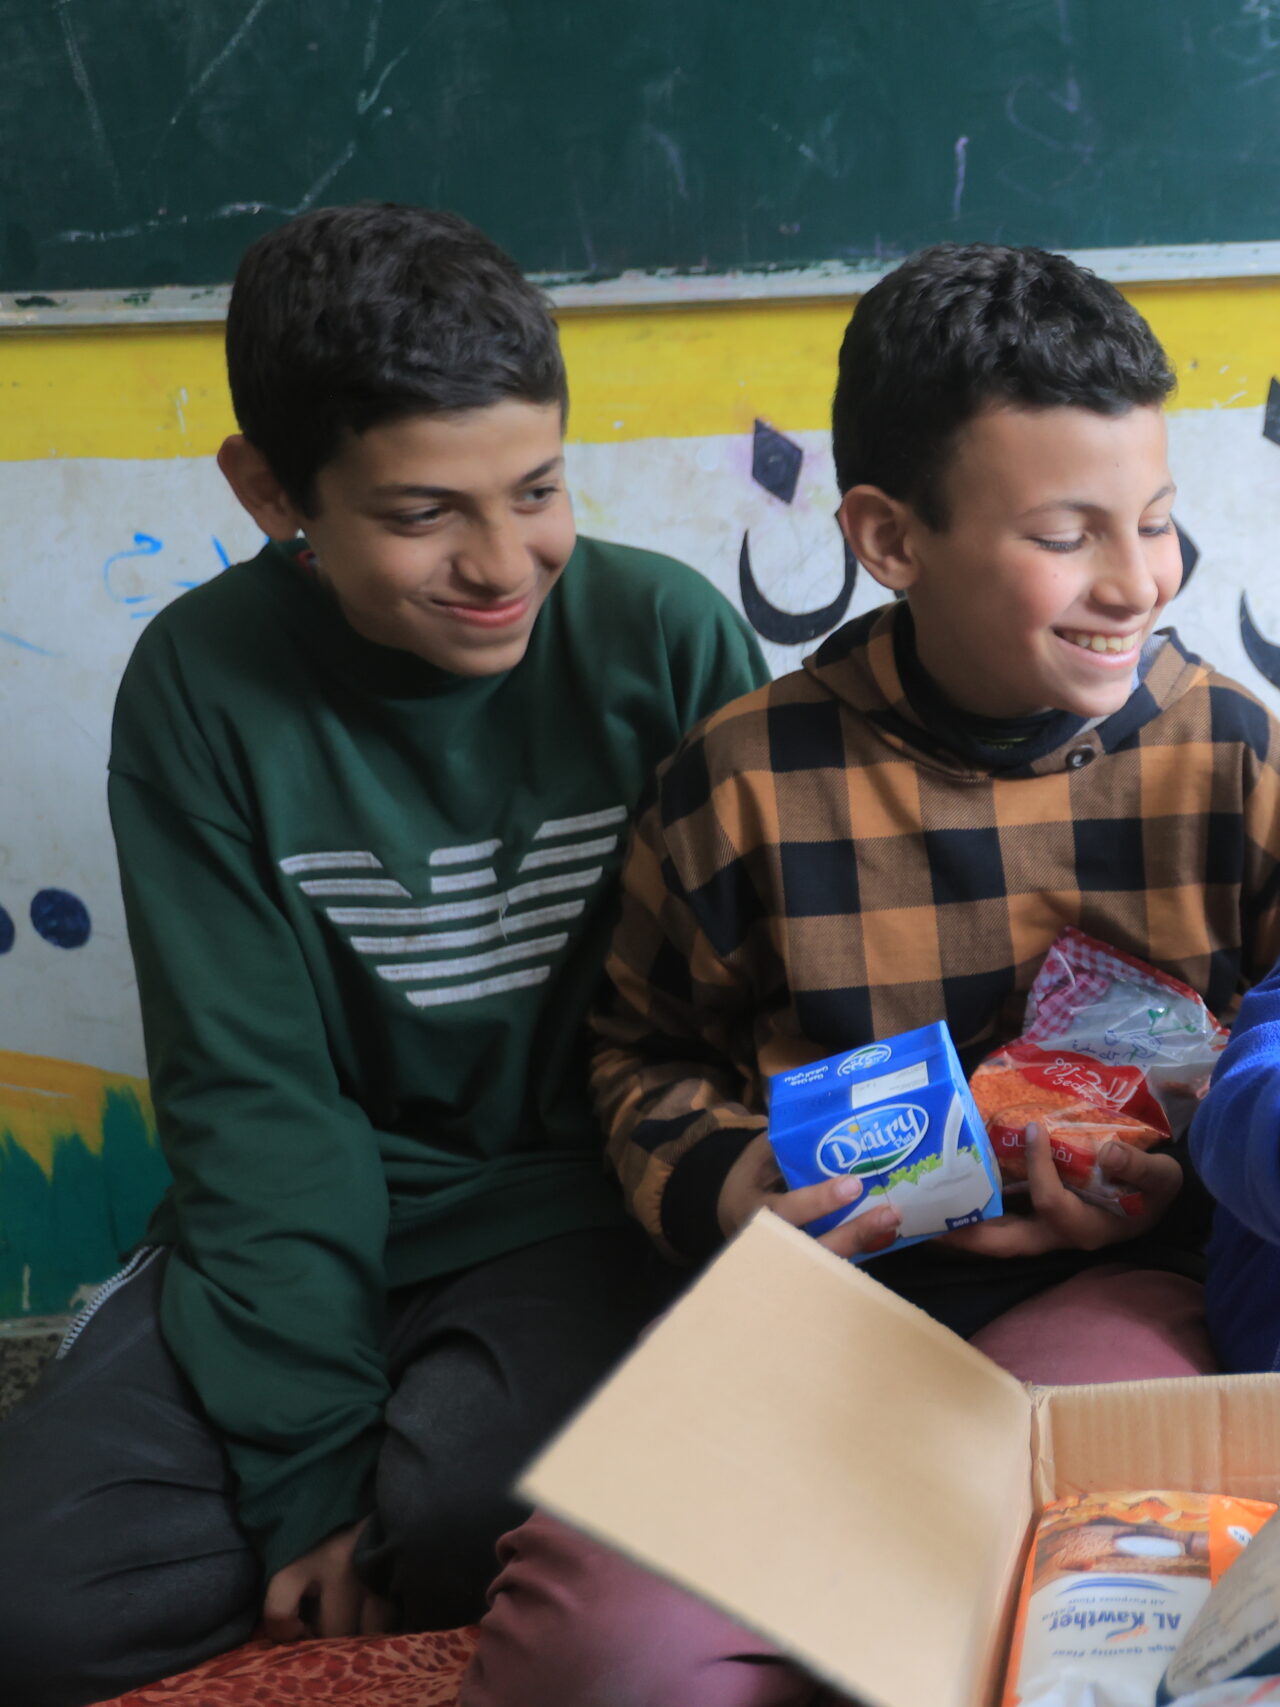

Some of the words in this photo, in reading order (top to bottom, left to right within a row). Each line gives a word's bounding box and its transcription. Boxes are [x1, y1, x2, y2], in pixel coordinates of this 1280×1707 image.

[825, 1106, 919, 1168] Dairy
[894, 1132, 915, 1149] Plus
[1049, 1609, 1145, 1636] Kawther
[1153, 1612, 1182, 1631] AL
